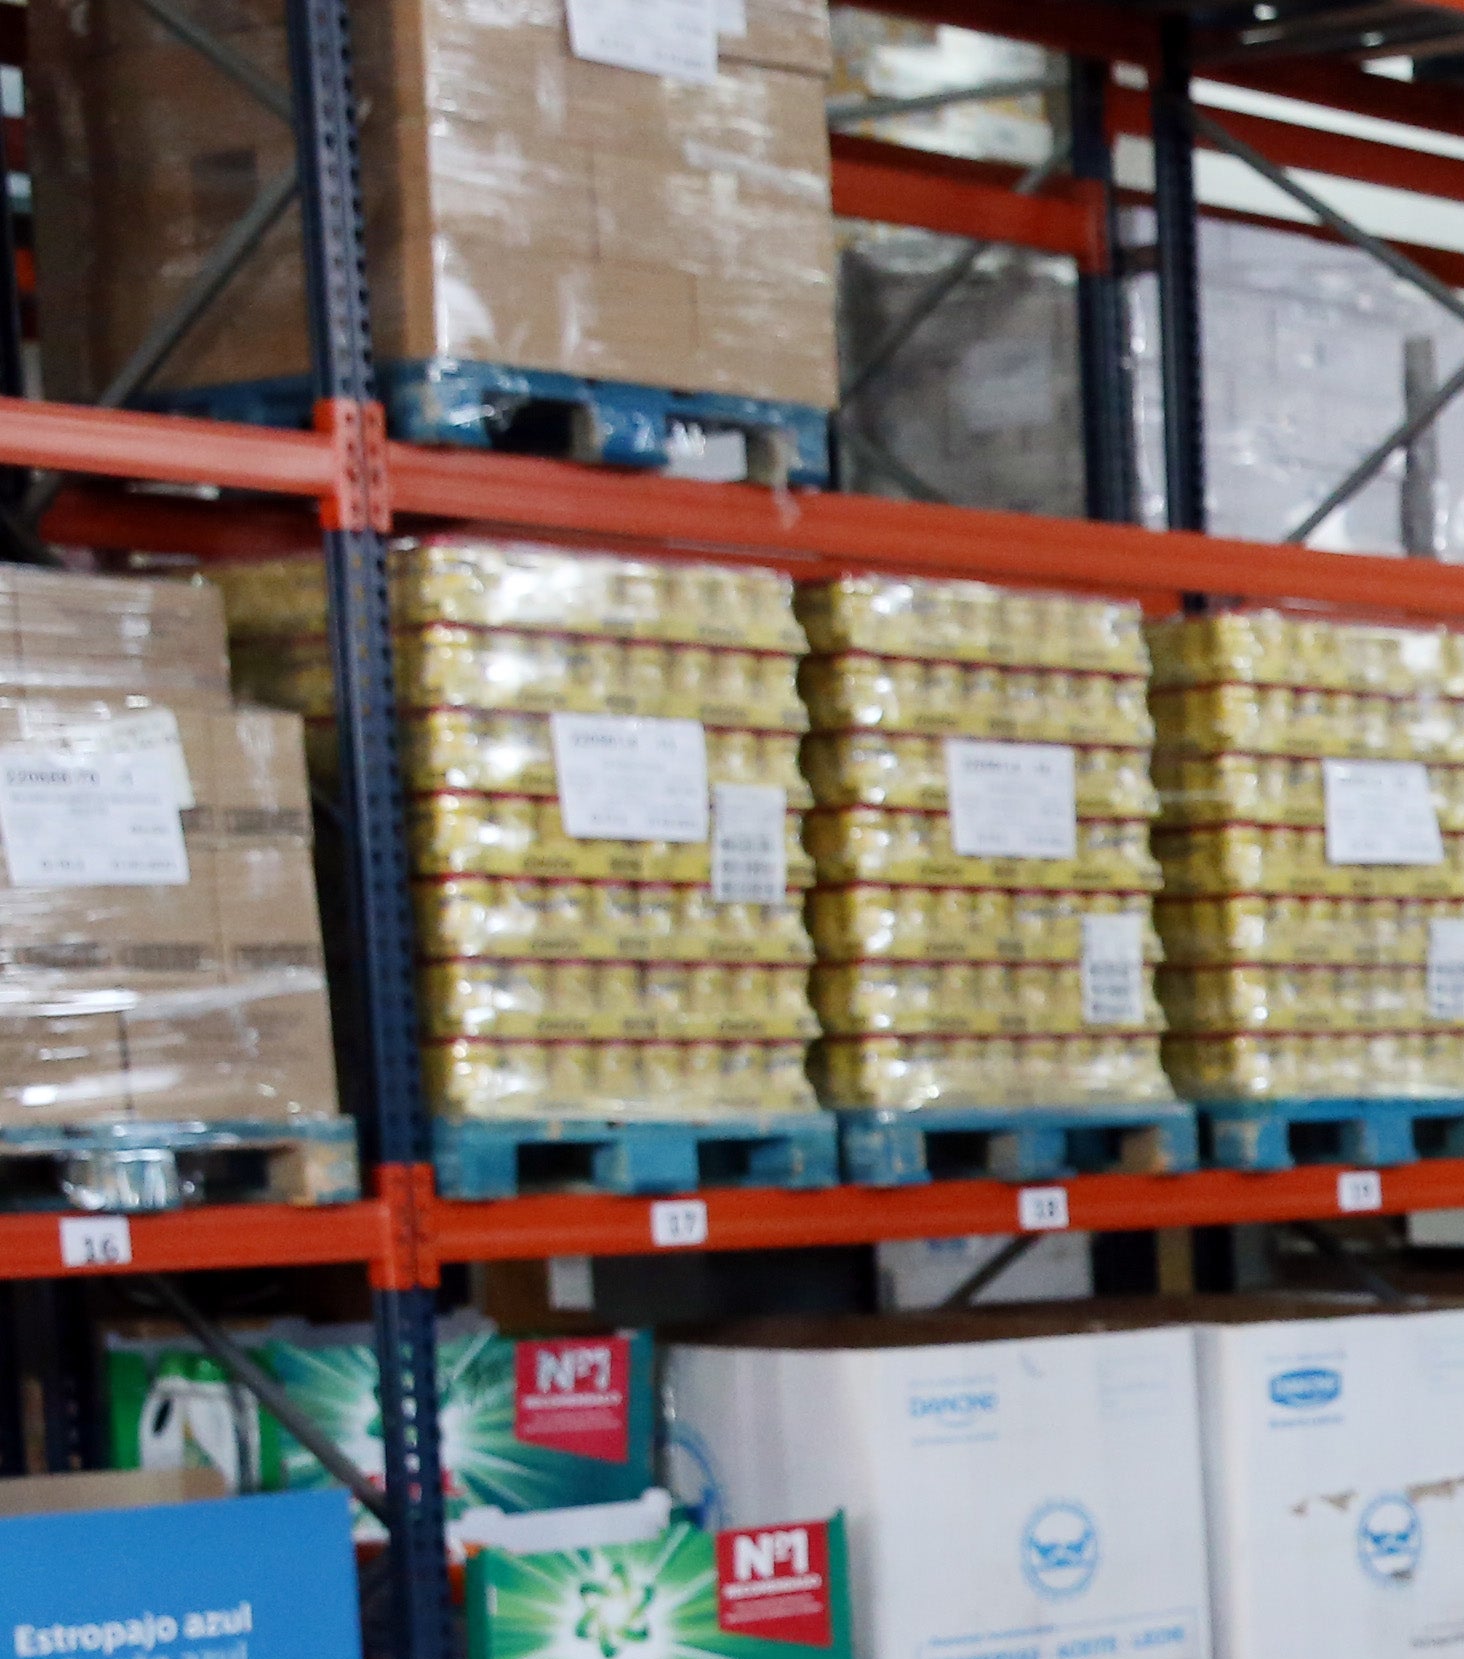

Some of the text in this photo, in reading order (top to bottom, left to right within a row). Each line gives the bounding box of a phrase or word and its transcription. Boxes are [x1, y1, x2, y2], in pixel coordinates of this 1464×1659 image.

[82, 1236, 120, 1264] 16
[14, 1602, 252, 1657] Estropajo azul
